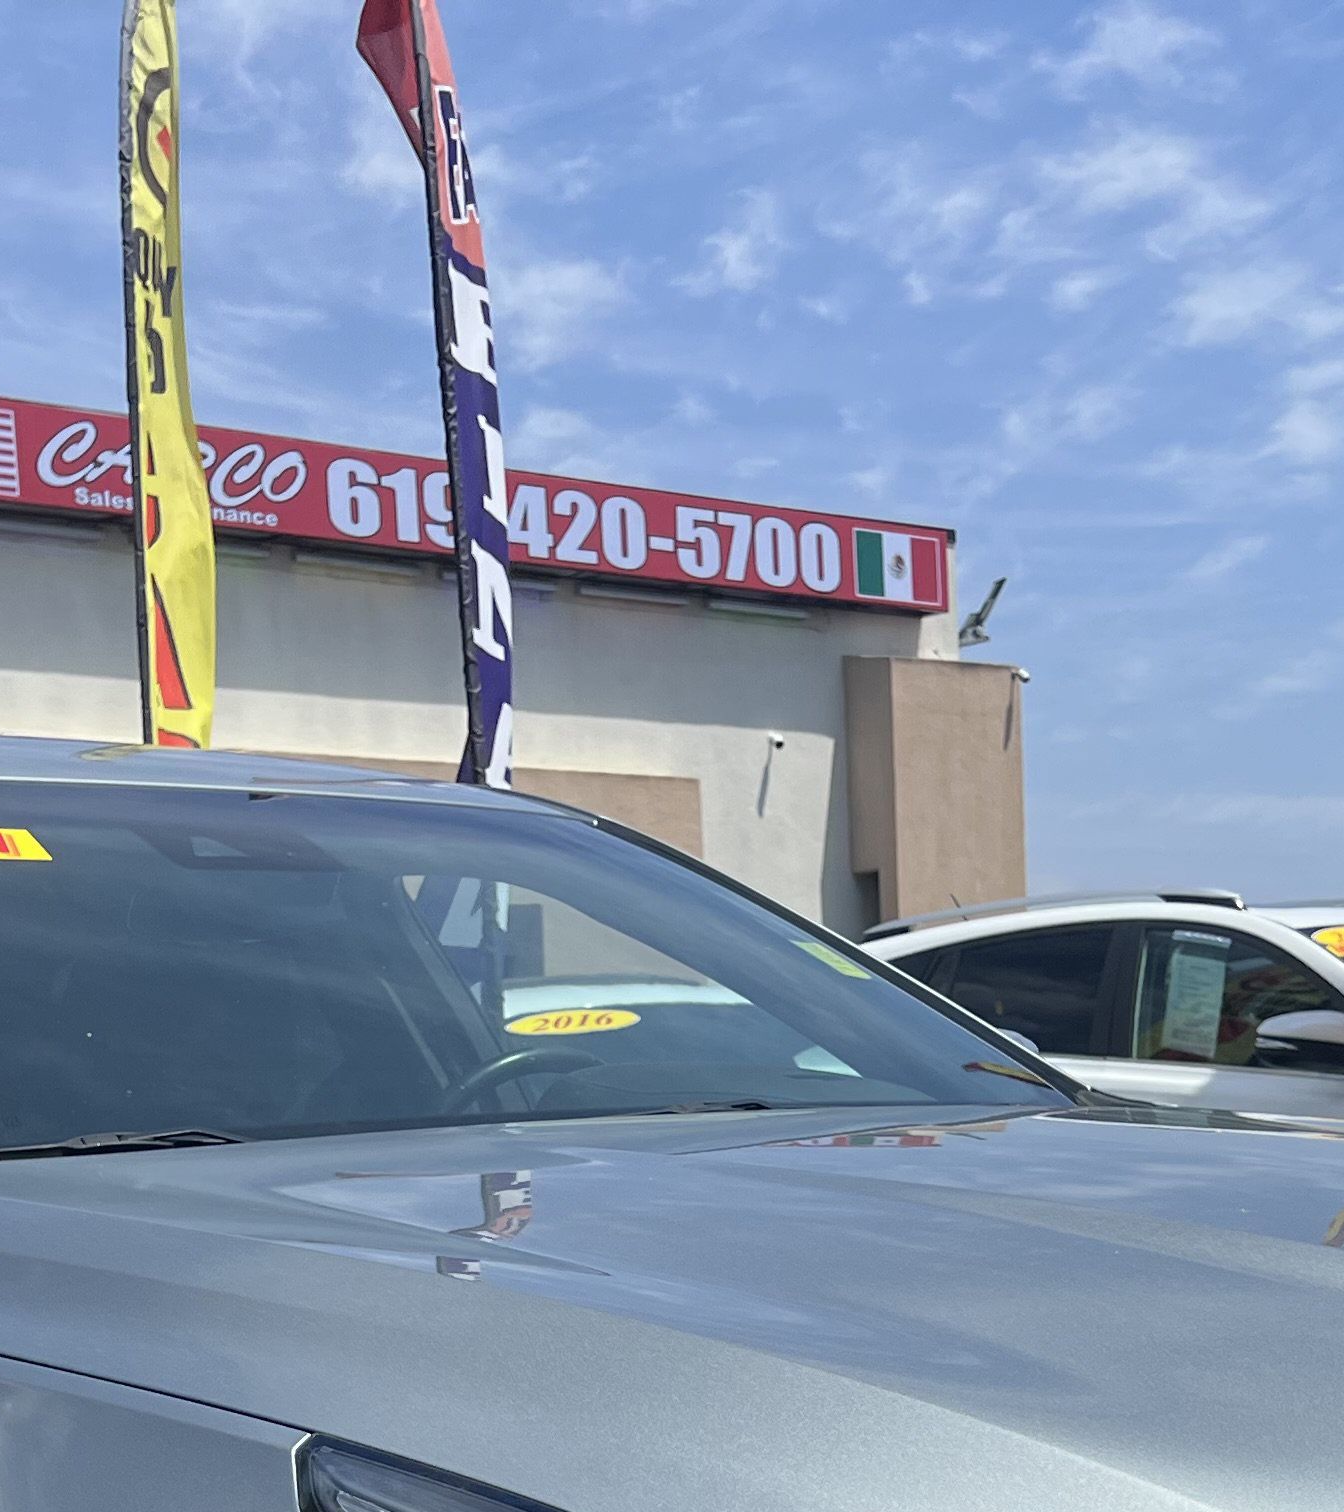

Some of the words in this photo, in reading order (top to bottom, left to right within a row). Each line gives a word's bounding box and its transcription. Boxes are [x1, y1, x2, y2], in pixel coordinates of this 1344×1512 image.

[36, 419, 308, 507] CACO
[325, 457, 455, 550] 619
[507, 483, 843, 593] 420-5700
[212, 505, 279, 527] nance
[531, 1011, 615, 1034] 2016
